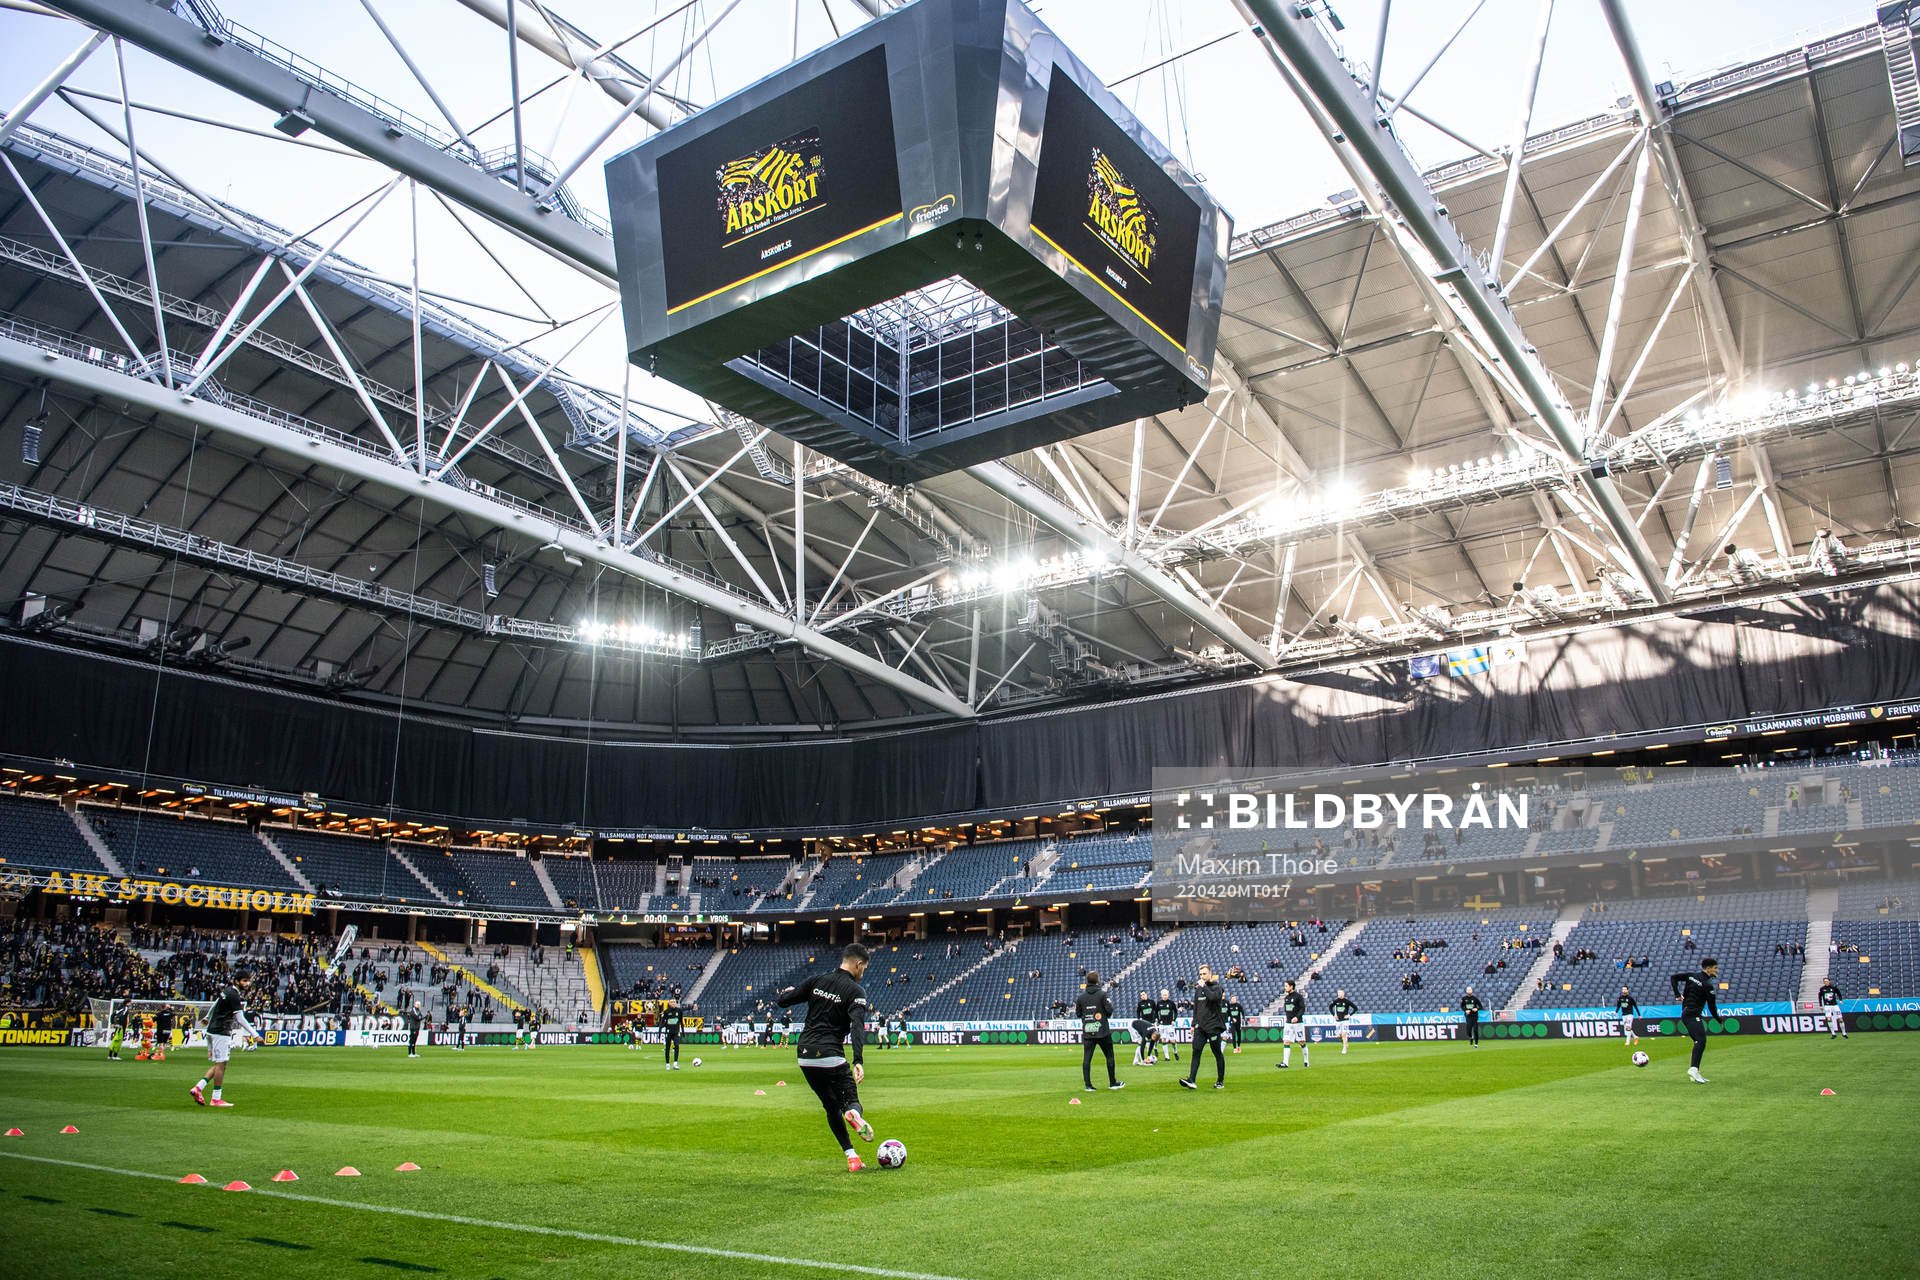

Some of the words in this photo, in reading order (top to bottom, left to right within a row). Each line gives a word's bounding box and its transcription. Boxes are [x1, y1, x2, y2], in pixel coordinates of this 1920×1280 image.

[726, 172, 818, 234] ÅRSKORT
[915, 204, 949, 222] friends
[1745, 718, 1803, 733] TILLSAMMANS
[1804, 717, 1821, 727] MOT
[1822, 710, 1867, 724] MOBBNING
[1888, 704, 1920, 716] FRIEND
[213, 789, 255, 801] TILLSAMMANS
[256, 795, 269, 803] MOT
[269, 797, 299, 807] MOBBNING
[1103, 798, 1139, 808] TILLSAMMANS
[42, 871, 112, 897] AIK
[118, 878, 317, 915] STOCKHOLM
[622, 914, 628, 922] 0
[644, 914, 668, 923] 00:00
[683, 915, 689, 923] 0
[813, 988, 837, 1001] CRAFT
[278, 1030, 337, 1045] PROJOB
[372, 1033, 409, 1042] TEKNO
[541, 1033, 579, 1044] UNIBET
[922, 1031, 964, 1044] UNIBET
[1037, 1030, 1083, 1044] UNIBET
[1395, 1024, 1459, 1040] UNIBET
